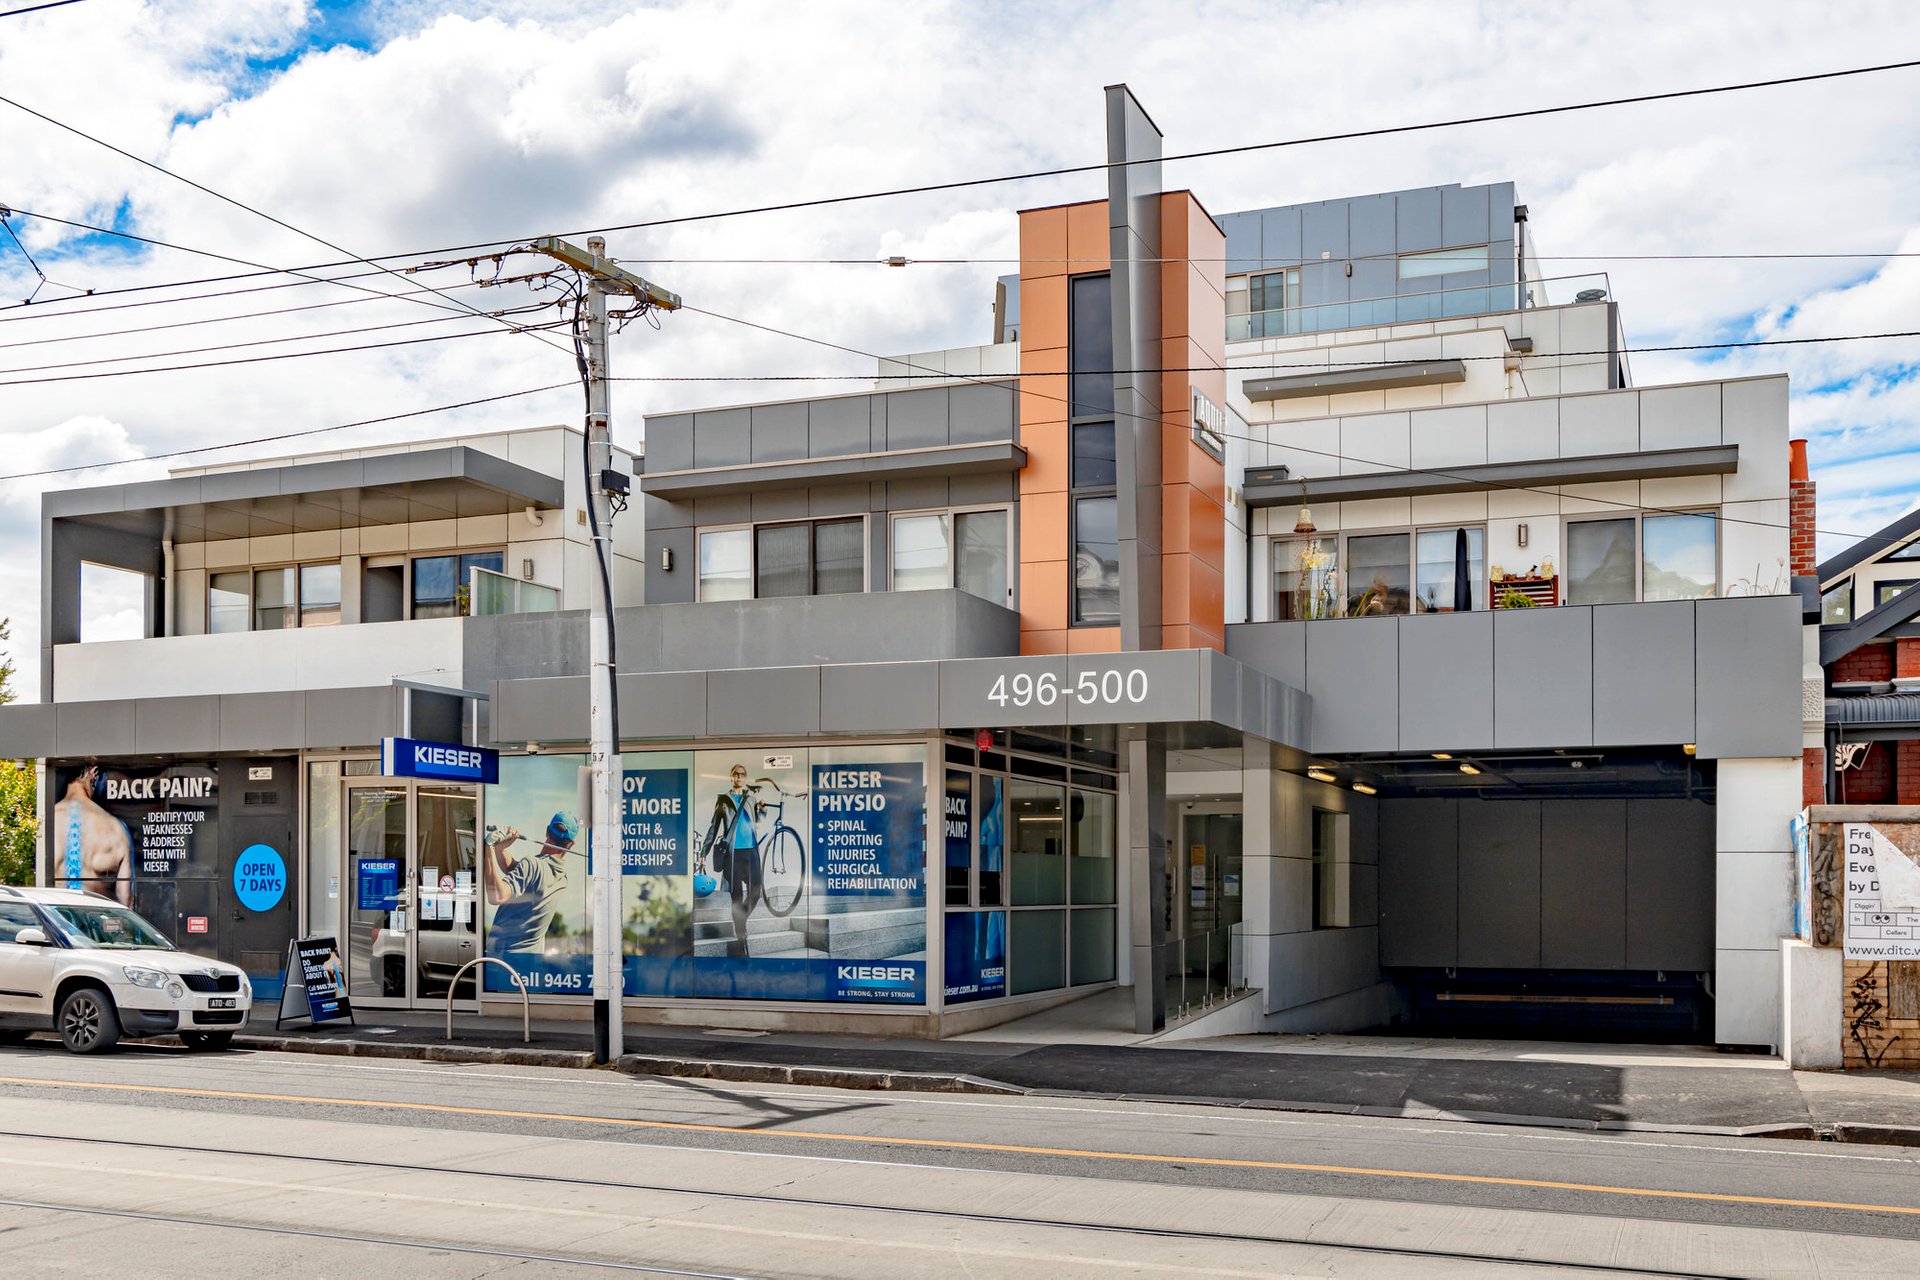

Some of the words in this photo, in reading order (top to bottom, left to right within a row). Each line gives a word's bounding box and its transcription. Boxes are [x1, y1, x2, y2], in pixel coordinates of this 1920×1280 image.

[987, 669, 1149, 707] 496-500
[415, 745, 482, 768] KIESER
[818, 771, 881, 789] KIESER
[107, 778, 154, 799] BACK
[159, 777, 213, 798] PAIN?
[632, 798, 681, 815] MORE
[818, 794, 886, 812] PHYSIO
[945, 797, 966, 815] BACK
[147, 812, 182, 823] IDENTIFY
[182, 811, 205, 822] YOUR
[142, 824, 193, 835] WEAKNESSES
[621, 823, 650, 835] NGTH
[654, 823, 663, 835] &
[827, 820, 866, 831] SPINAL
[945, 821, 968, 838] PAIN?
[827, 834, 883, 846] SPORTING
[1850, 829, 1871, 839] Fre
[142, 838, 149, 847] &
[150, 837, 185, 847] ADDRESS
[621, 838, 676, 850] DITIONING
[142, 849, 165, 859] THEM
[165, 849, 186, 859] WITH
[621, 854, 673, 866] BERSHIPS
[827, 849, 876, 860] INJURIES
[143, 861, 169, 872] KIESER
[242, 863, 275, 877] OPEN
[361, 862, 395, 870] KIESER
[827, 863, 882, 875] SURGICAL
[1850, 862, 1877, 873] Eve
[239, 878, 247, 892] 7
[250, 878, 281, 892] DAYS
[827, 877, 917, 890] REHABILITATION
[1849, 881, 1865, 893] by
[1870, 881, 1880, 891] D
[300, 950, 315, 958] BACK
[305, 972, 323, 980] ABOUT
[838, 966, 916, 981] KIESER
[980, 967, 1004, 979] KIESER
[510, 972, 539, 987] Call
[544, 973, 581, 988] 9445
